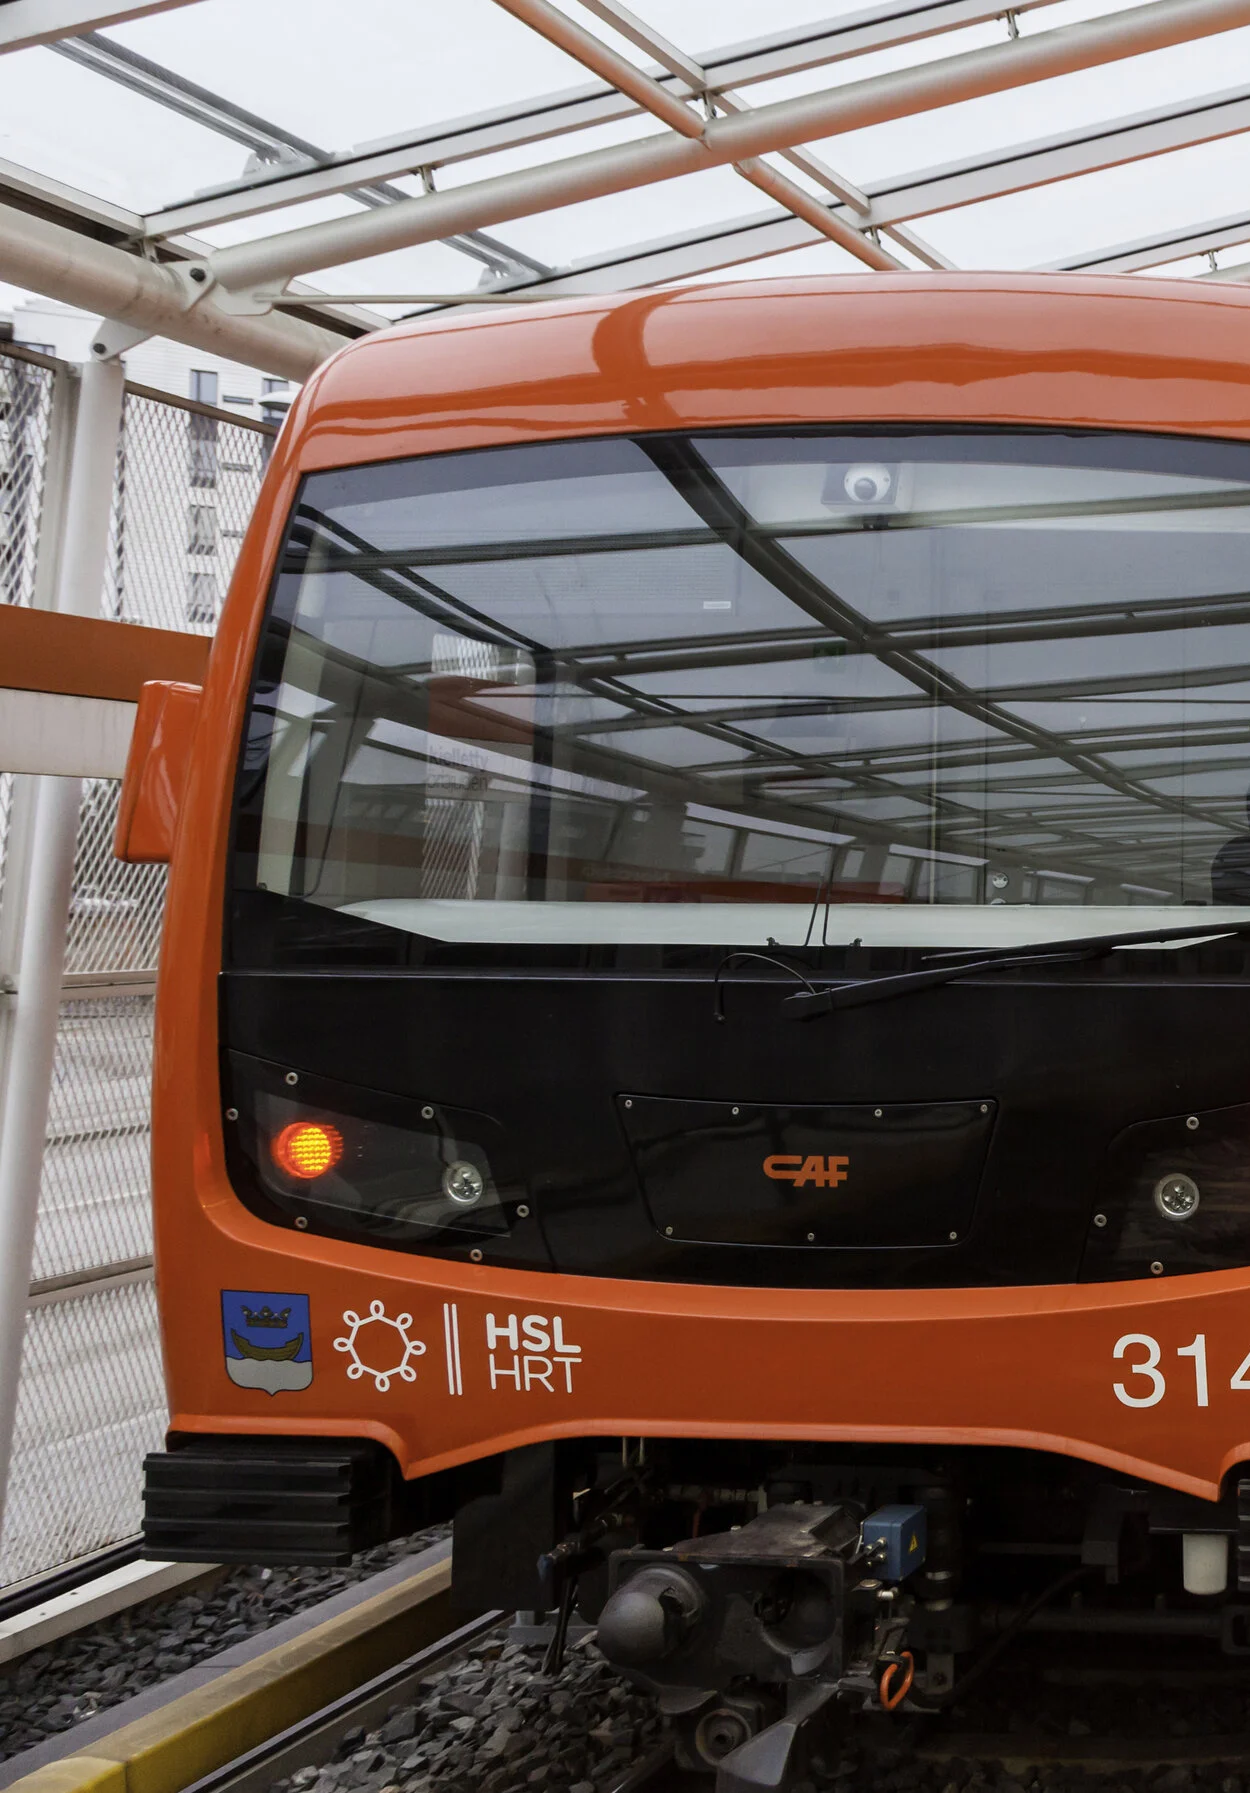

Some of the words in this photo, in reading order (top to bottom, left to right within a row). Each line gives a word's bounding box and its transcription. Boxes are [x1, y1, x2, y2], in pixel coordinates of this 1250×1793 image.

[763, 1154, 849, 1188] CAF
[485, 1312, 582, 1354] HSL
[488, 1354, 582, 1393] HRT
